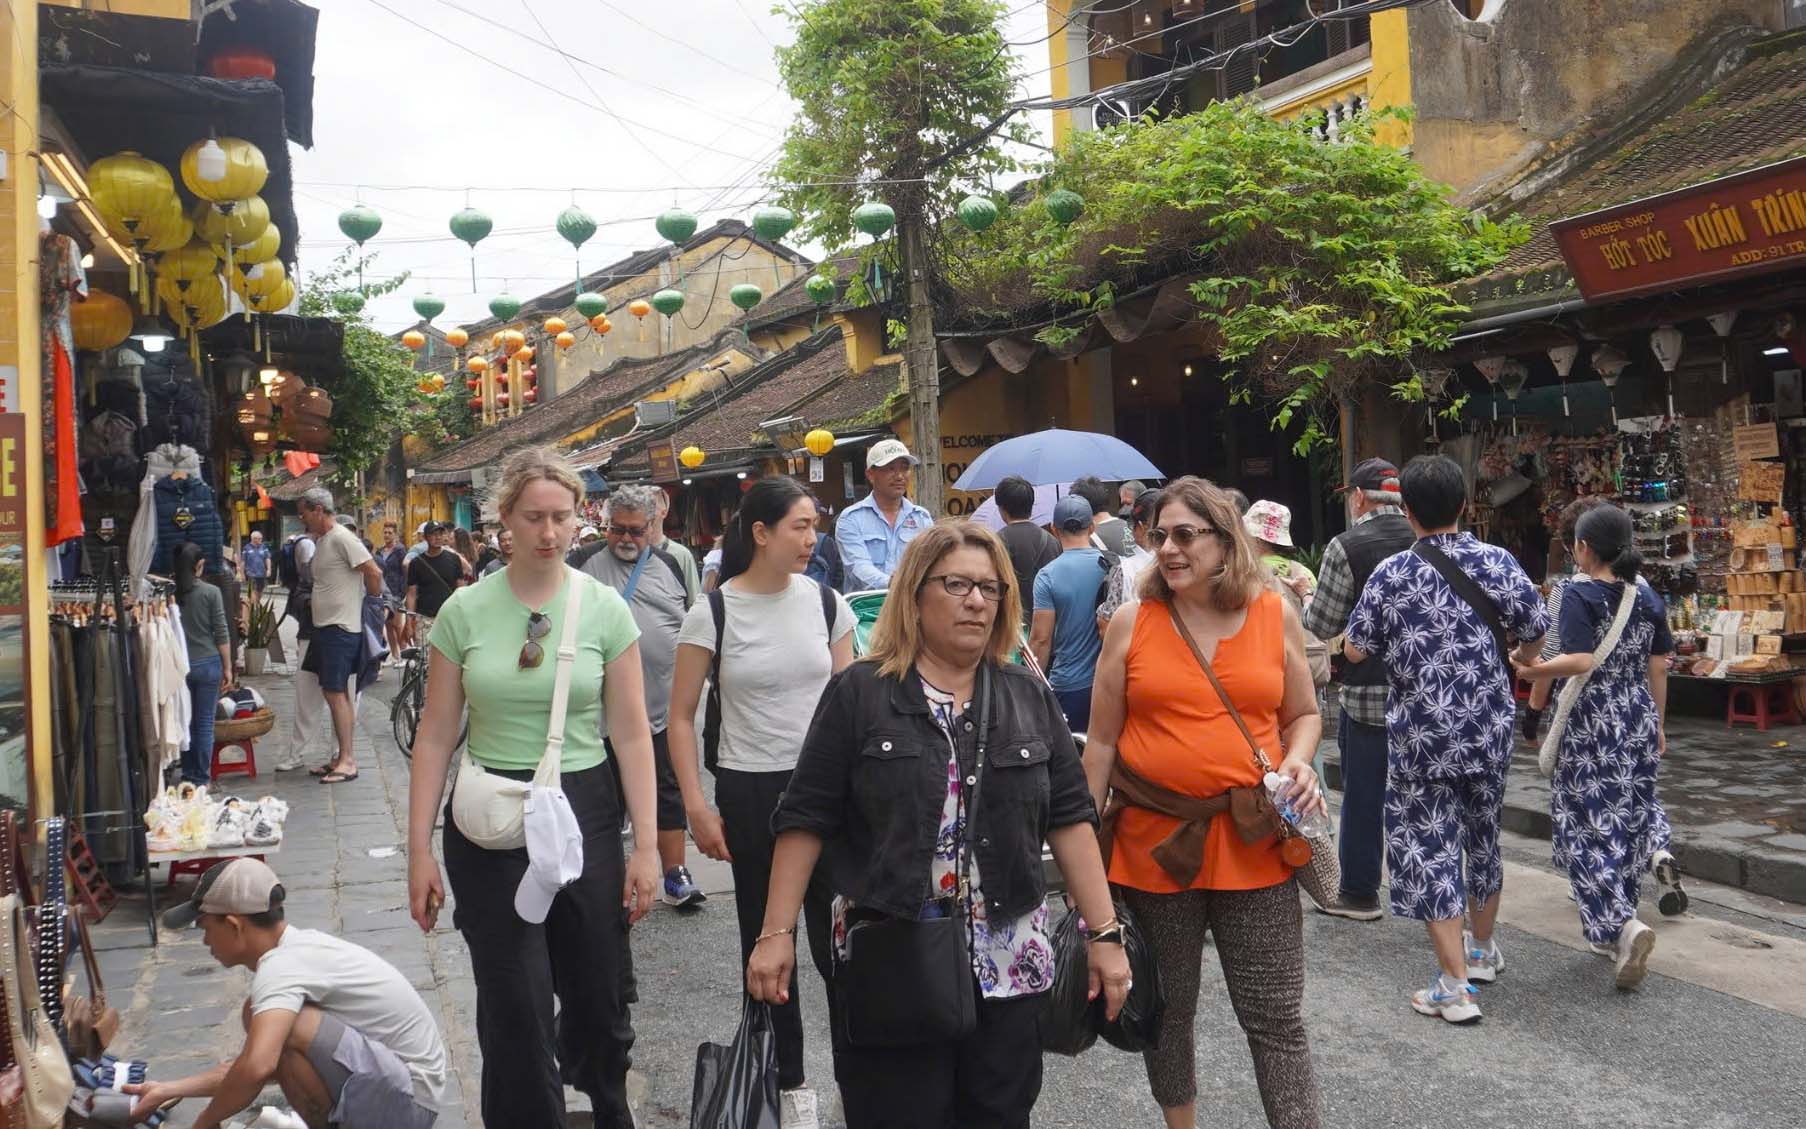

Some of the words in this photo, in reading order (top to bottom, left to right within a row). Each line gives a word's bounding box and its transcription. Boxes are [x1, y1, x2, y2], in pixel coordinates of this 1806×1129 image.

[1580, 221, 1624, 239] BARBER
[1624, 211, 1656, 228] SHOP
[1684, 202, 1747, 252] XUÂN
[1731, 249, 1767, 266] ADD:
[1767, 245, 1787, 258] 91
